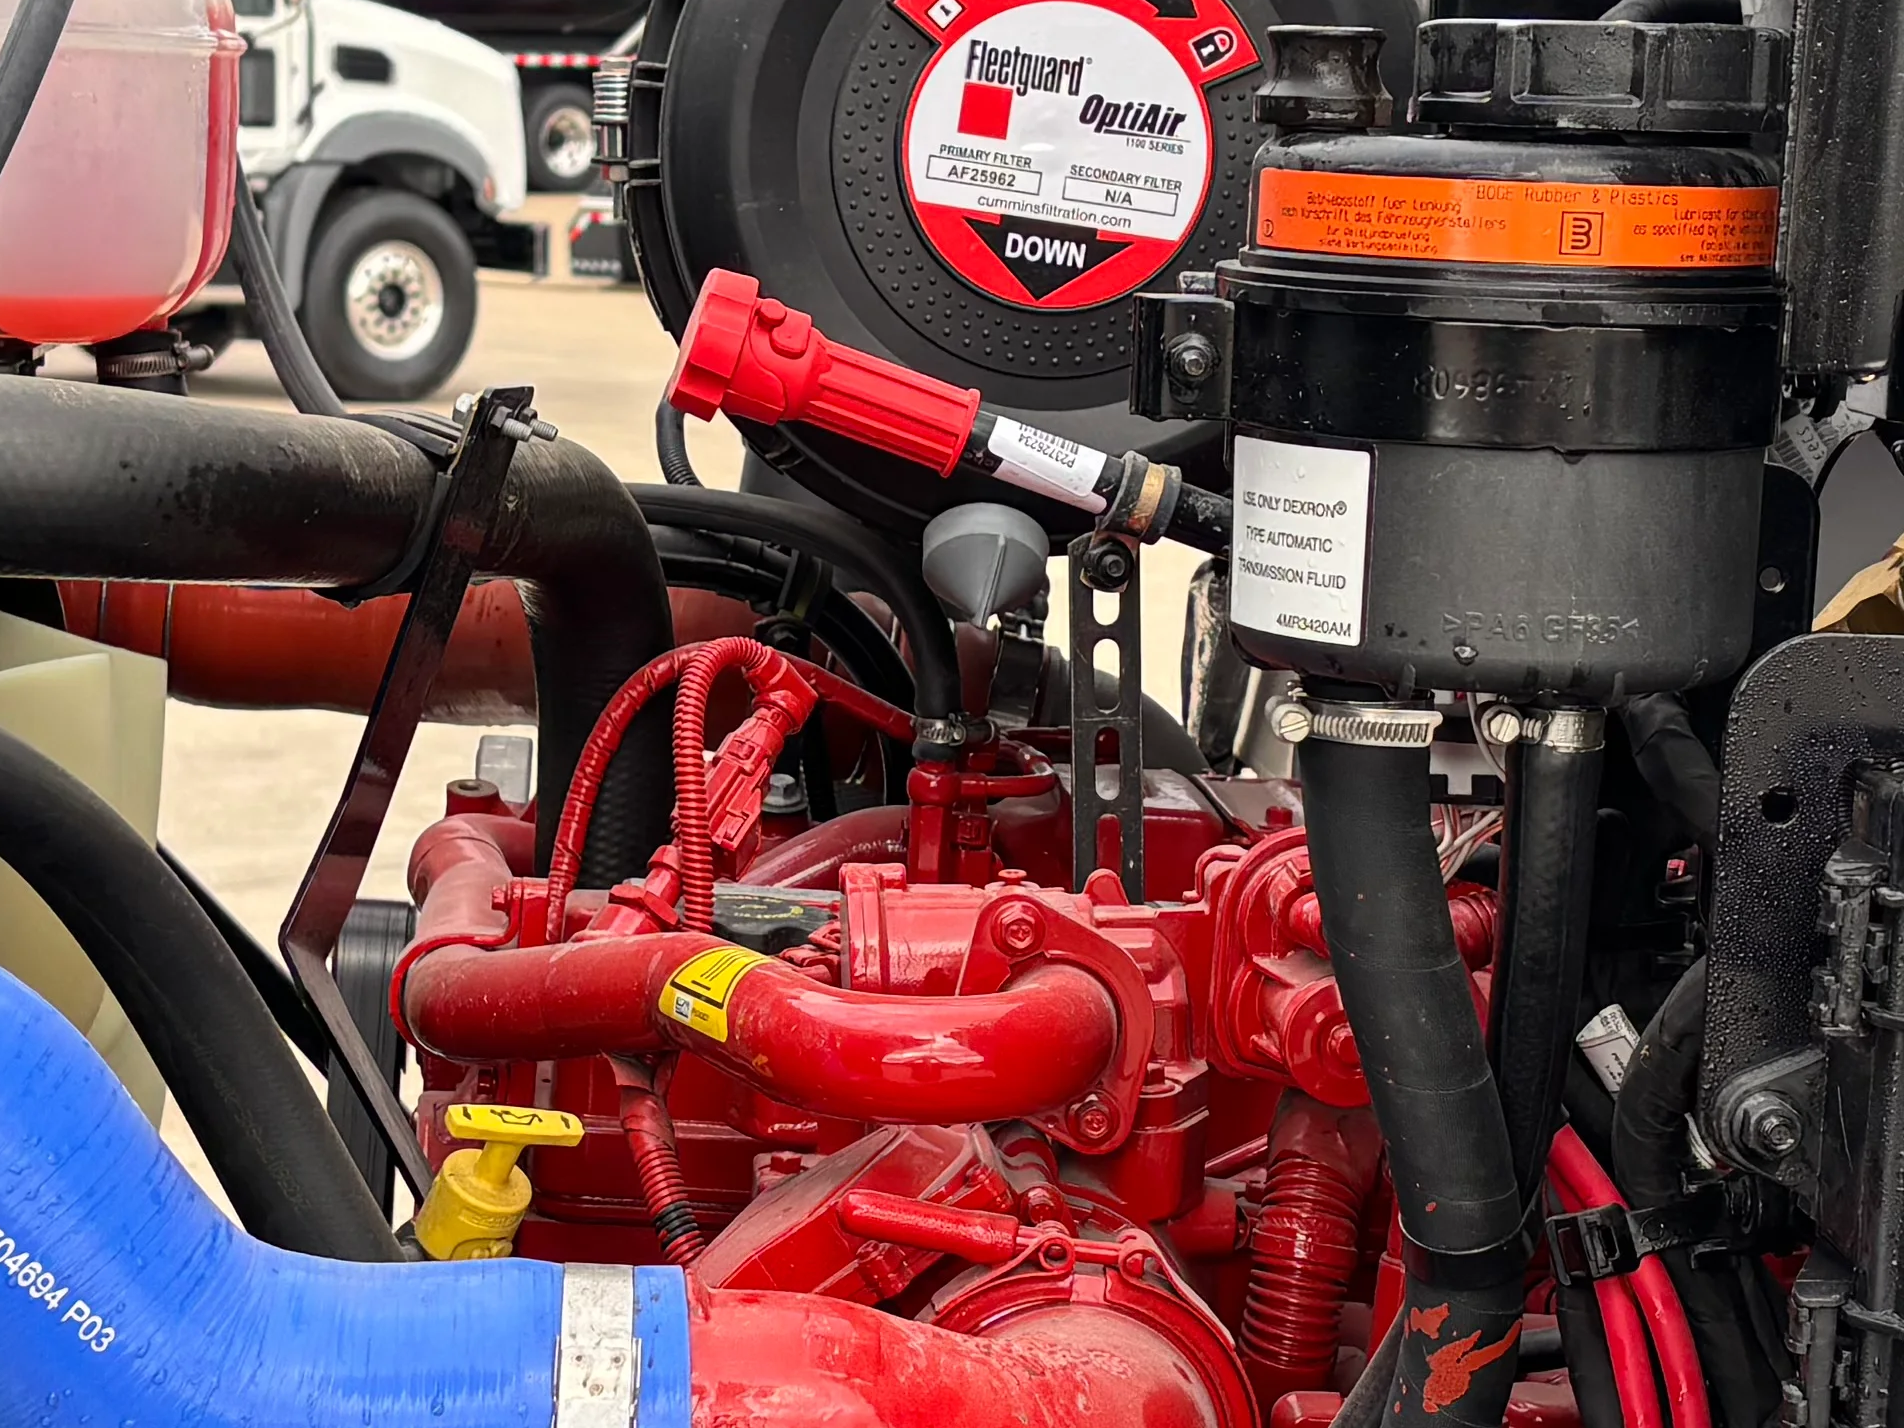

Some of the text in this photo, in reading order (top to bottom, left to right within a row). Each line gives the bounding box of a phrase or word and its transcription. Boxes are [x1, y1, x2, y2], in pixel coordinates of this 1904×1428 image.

[940, 144, 1033, 169] PRIMARY FILTER
[1147, 139, 1185, 155] SERIES
[947, 163, 1016, 187] AF25962
[1069, 164, 1183, 192] SECONDARY FILTER
[1104, 188, 1134, 206] N/A
[1524, 188, 1582, 204] Rubber
[1610, 192, 1679, 207] Plastics
[977, 195, 1132, 229] cumminsfiltration.com
[1004, 232, 1087, 269] DOWN
[1257, 493, 1282, 510] ONLY
[1245, 525, 1333, 553] TYPE AUTOMATIC
[1306, 571, 1347, 590] FLUID
[62, 1298, 117, 1354] P03
